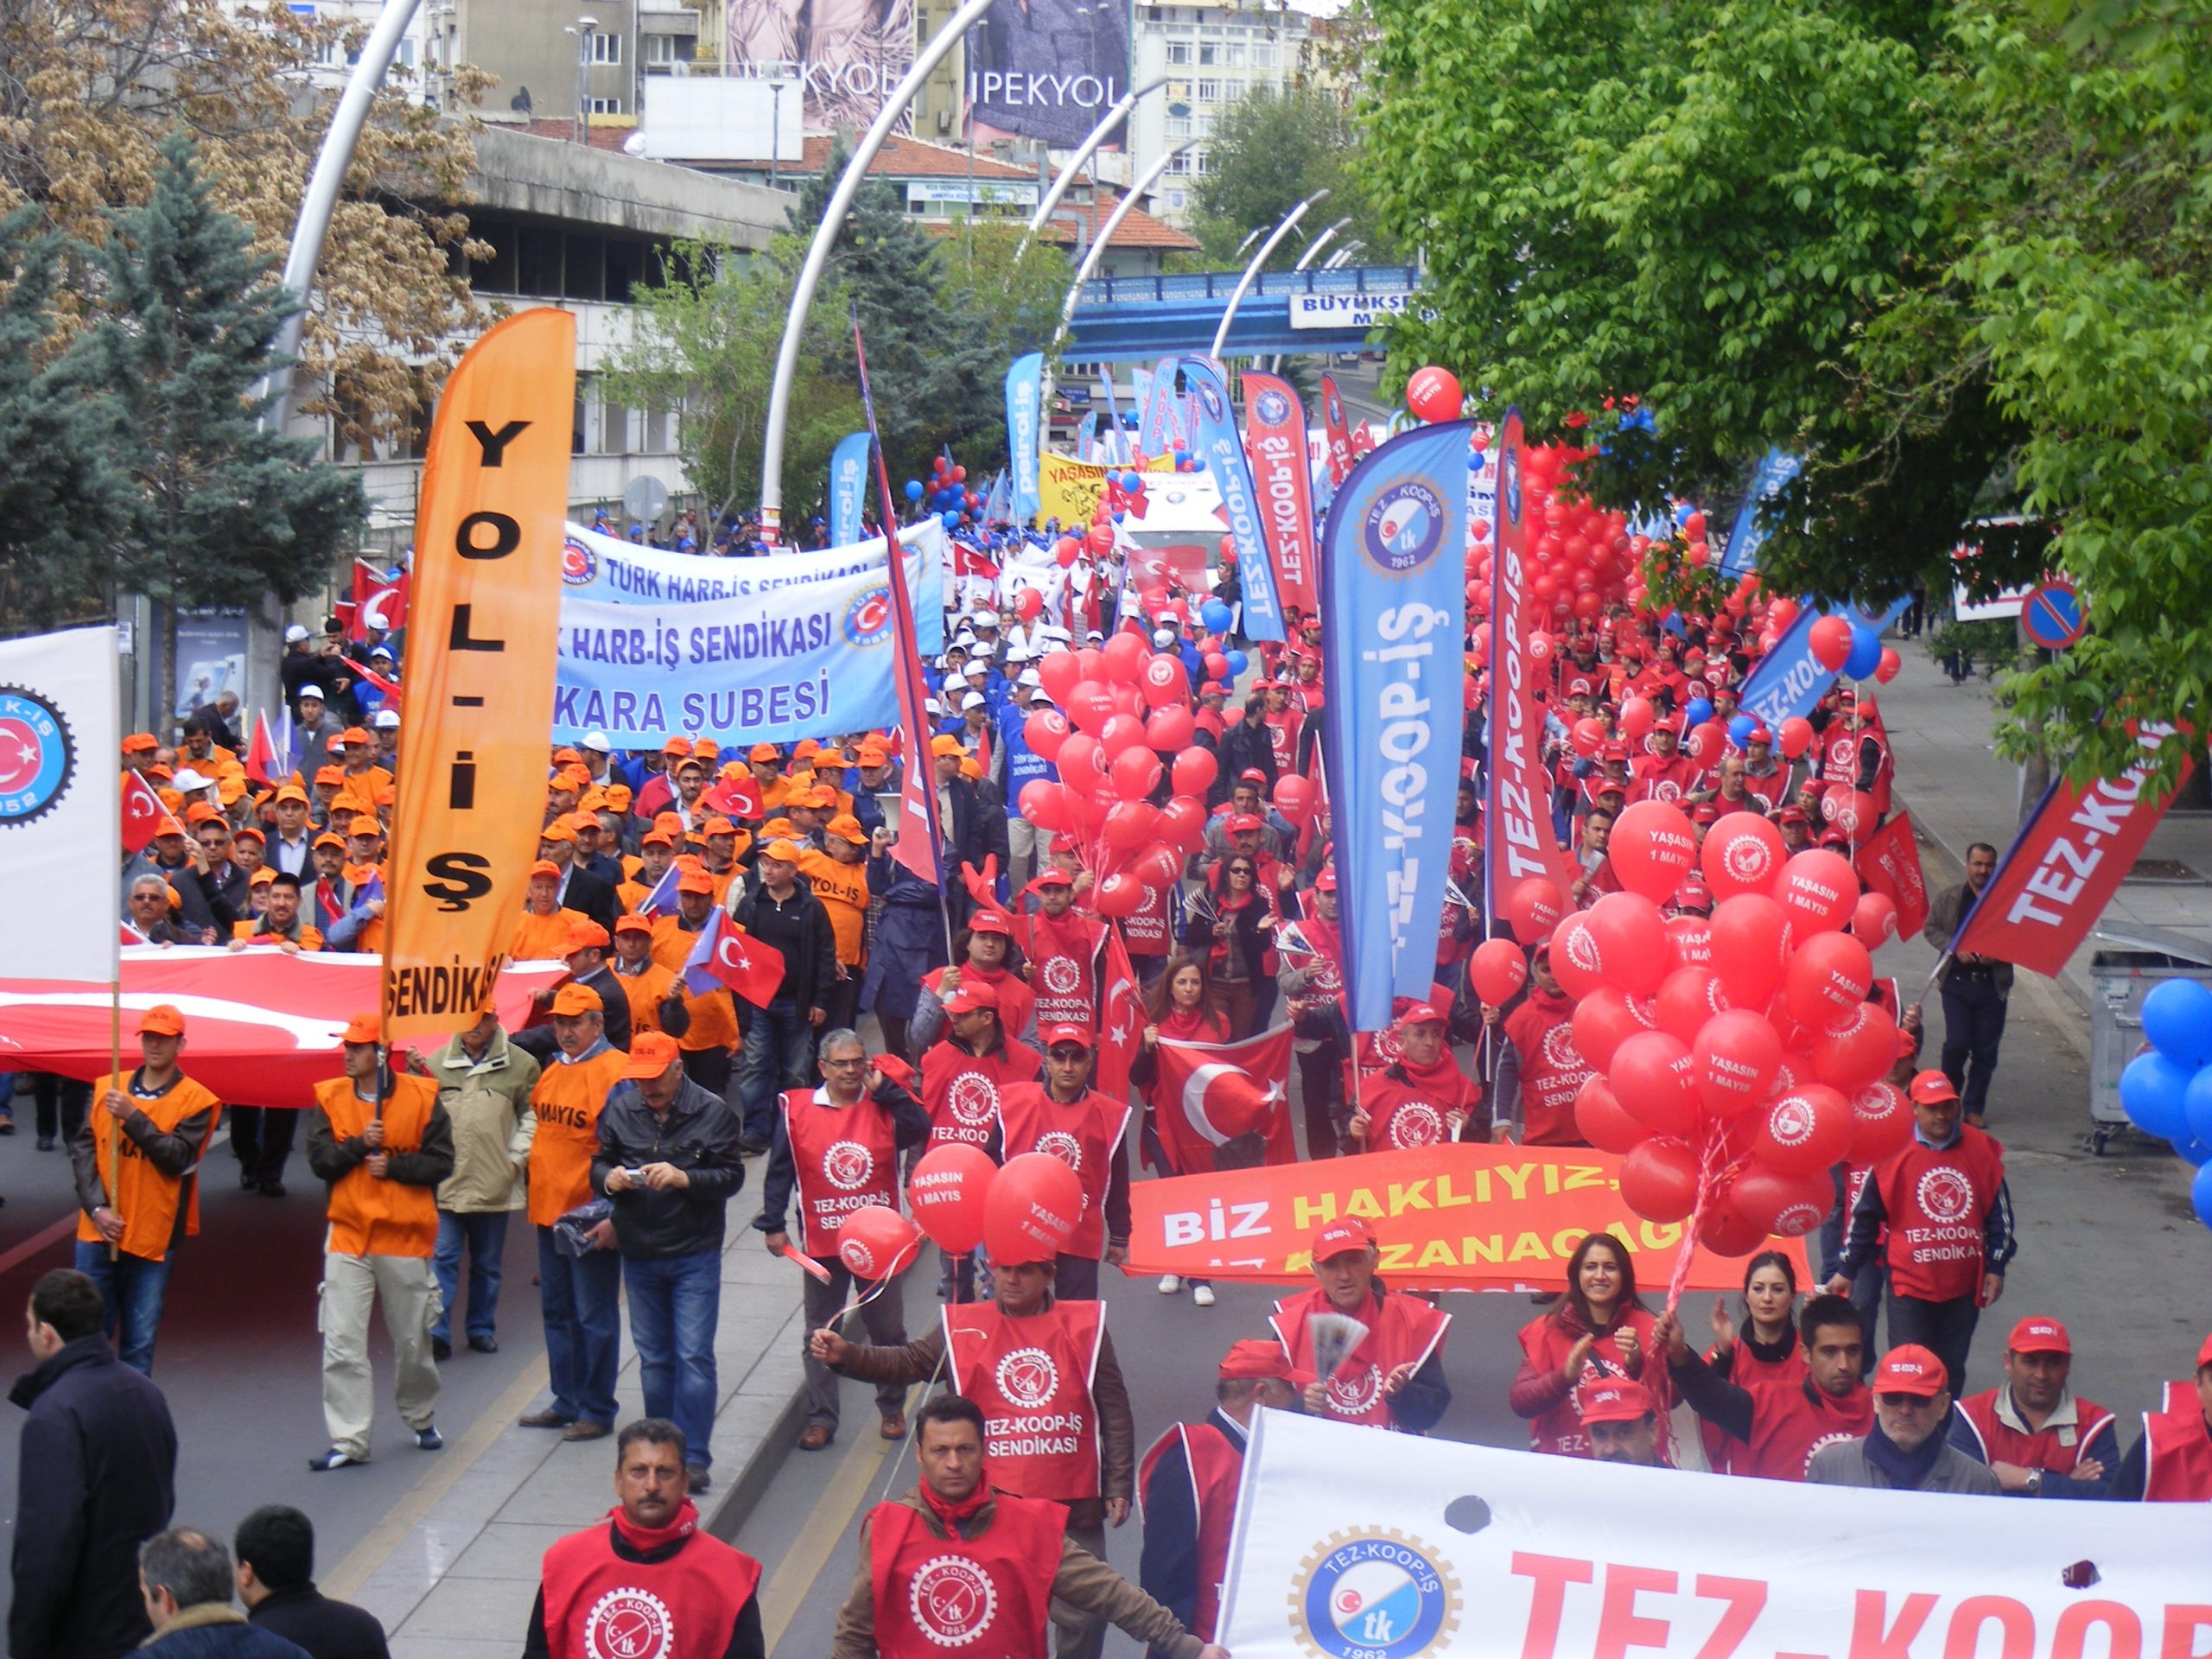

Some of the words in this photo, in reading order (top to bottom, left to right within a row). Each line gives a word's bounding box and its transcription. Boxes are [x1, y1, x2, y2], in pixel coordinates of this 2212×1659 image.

[971, 71, 1121, 109] IPEKYOL
[606, 557, 661, 598] TÜRK
[572, 618, 680, 671] HARB-İŞ
[689, 610, 831, 665] SENDİKASI
[423, 420, 531, 912] YOL-İŞ
[681, 668, 830, 741] ŞUBESİ
[1649, 830, 1694, 852] YAŞASIN
[1650, 849, 1657, 862] 1
[1791, 874, 1839, 903] YAŞASIN
[1788, 892, 1794, 904] 1
[1795, 895, 1829, 917] MAYIS
[1710, 1053, 1759, 1078] YAŞASIN
[1714, 1074, 1751, 1093] MAYIS
[541, 1102, 605, 1130] MAYIS
[913, 1171, 963, 1190] YAŞASIN
[923, 1189, 962, 1207] MAYIS
[1163, 1197, 1273, 1249] BİZ
[1293, 1161, 1623, 1230] HAKLIYIZ,
[984, 1411, 1083, 1437] TEZ-KOOP-İŞ
[988, 1435, 1078, 1458] SENDİKASI
[919, 1577, 936, 1598] TEZ
[597, 1605, 618, 1625] TEZ
[948, 1604, 963, 1621] tk
[1363, 1608, 1395, 1643] tk
[620, 1636, 637, 1655] tk
